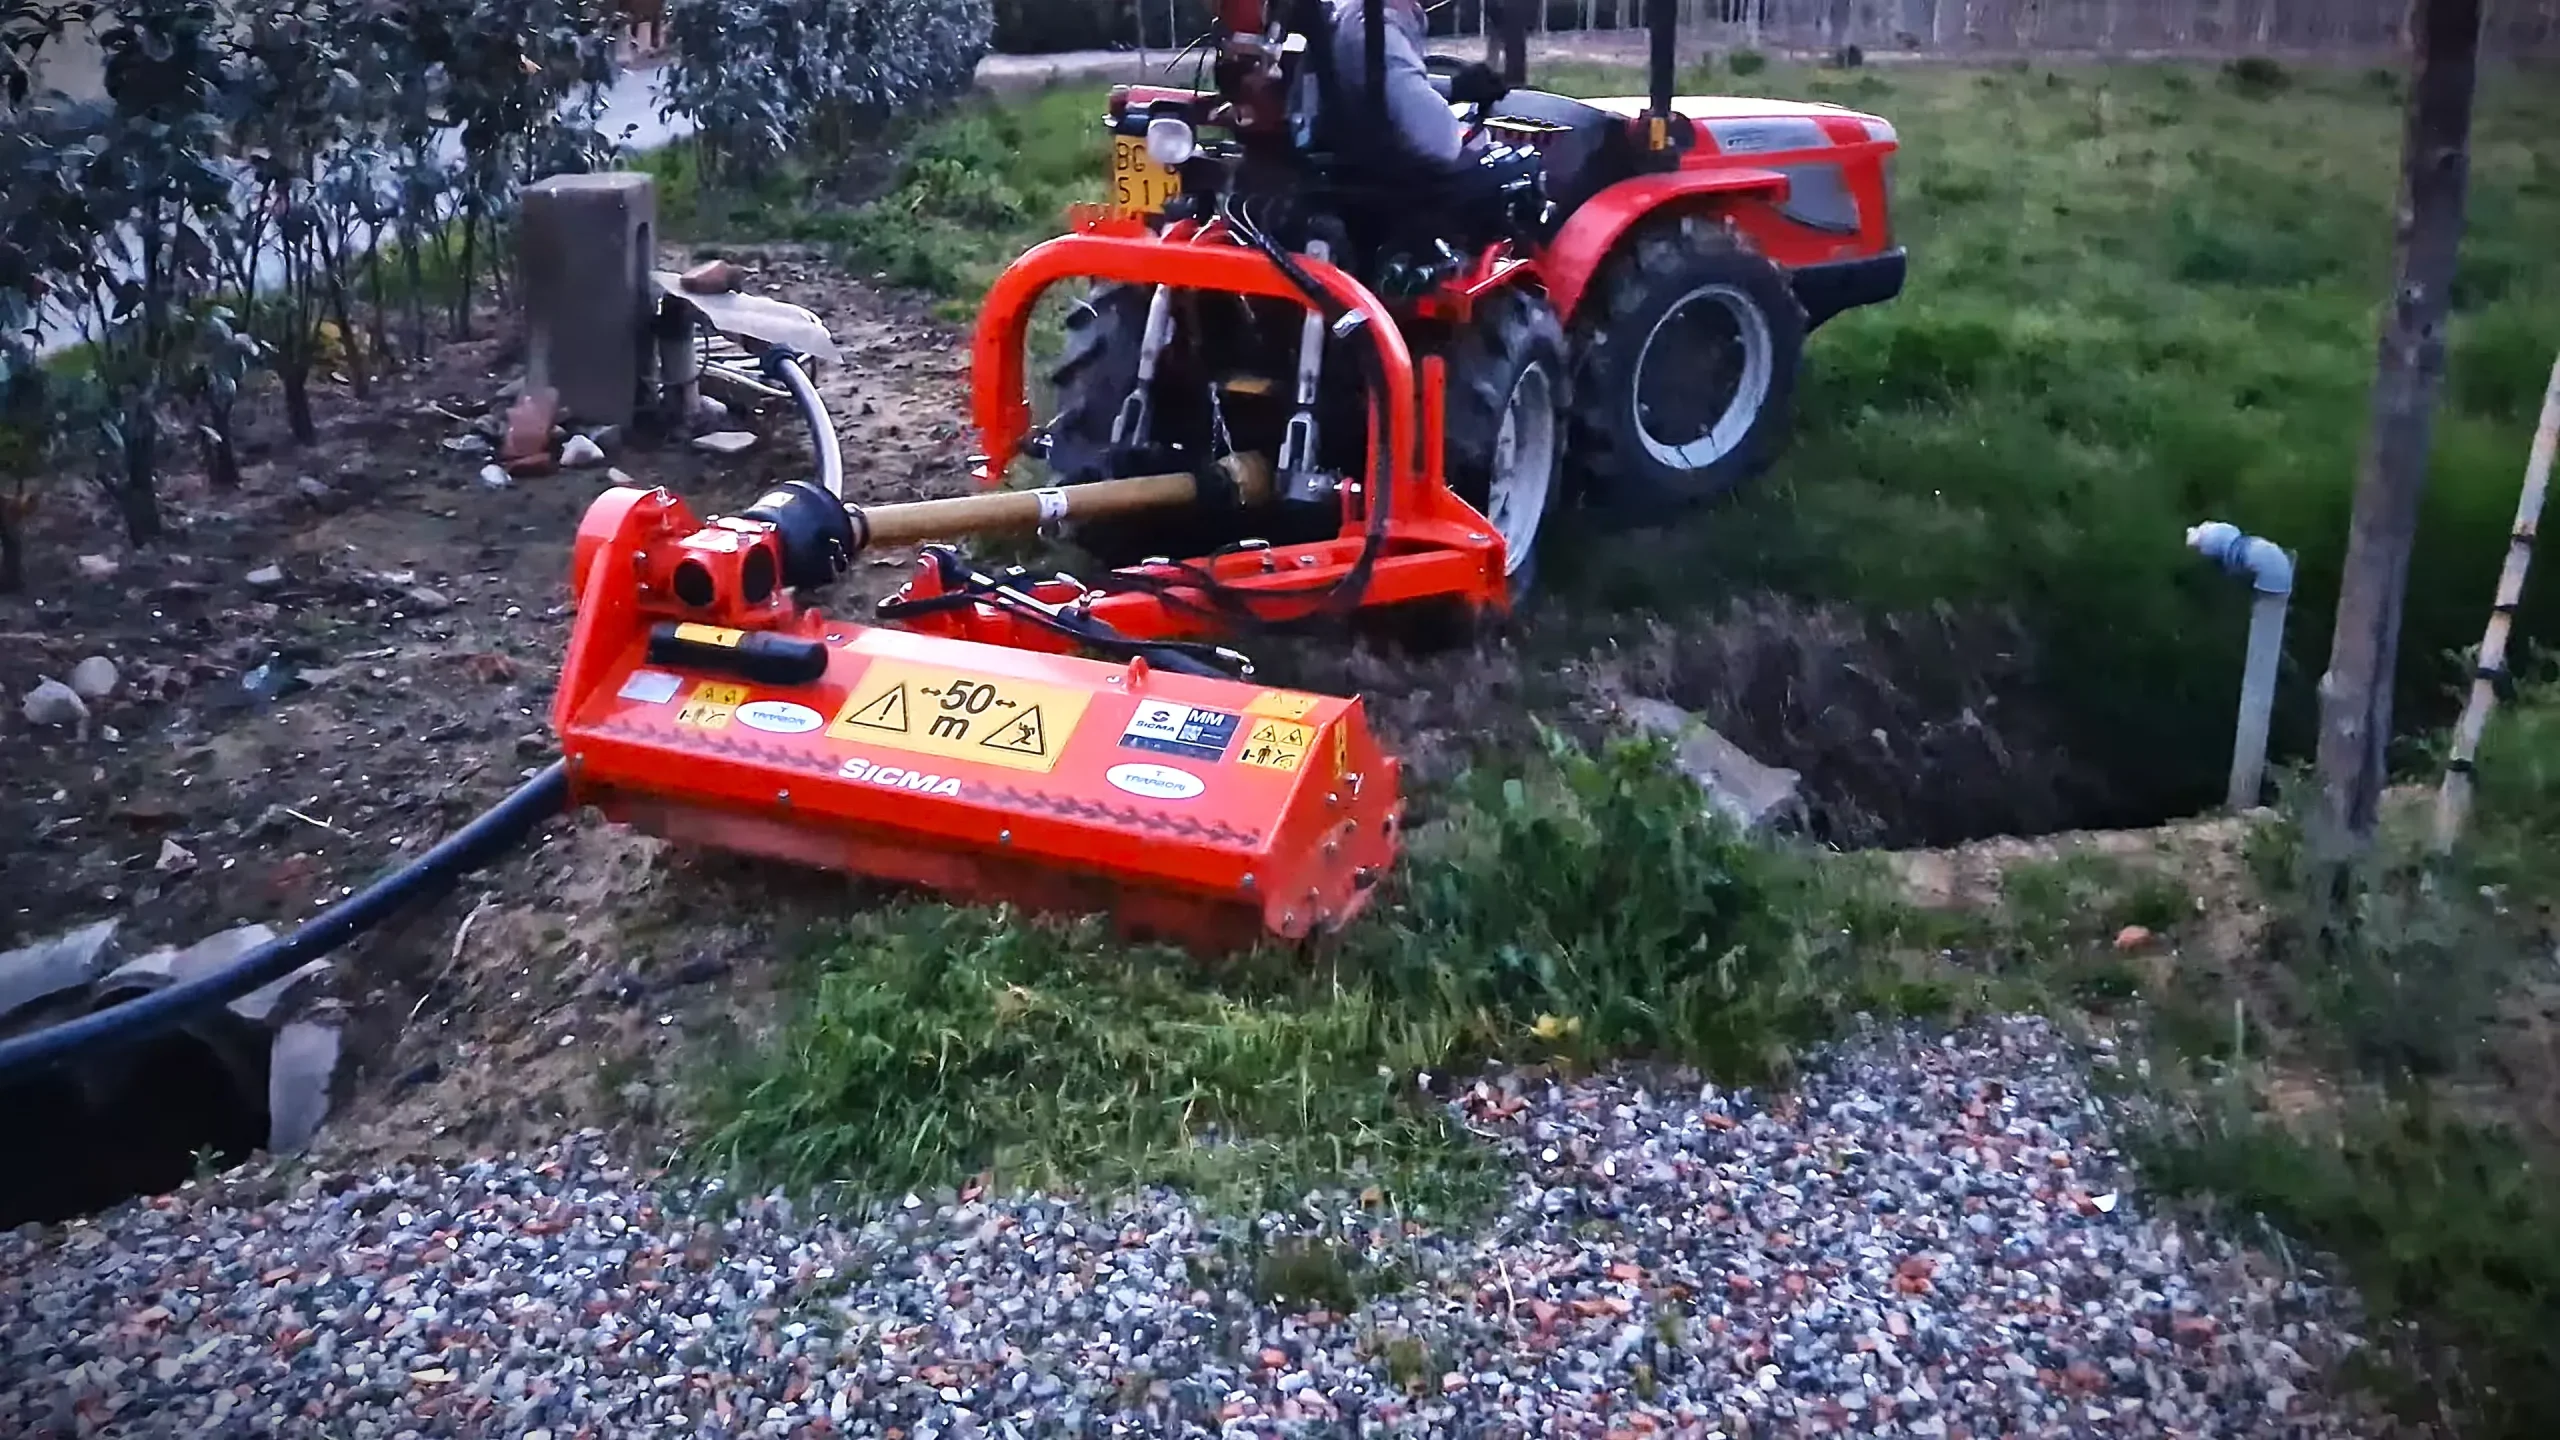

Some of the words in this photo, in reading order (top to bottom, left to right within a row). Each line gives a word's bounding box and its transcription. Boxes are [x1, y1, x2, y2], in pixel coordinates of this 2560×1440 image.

[940, 679, 996, 714] 50
[928, 715, 970, 740] m
[1188, 709, 1225, 727] MM
[837, 757, 963, 797] SICMA
